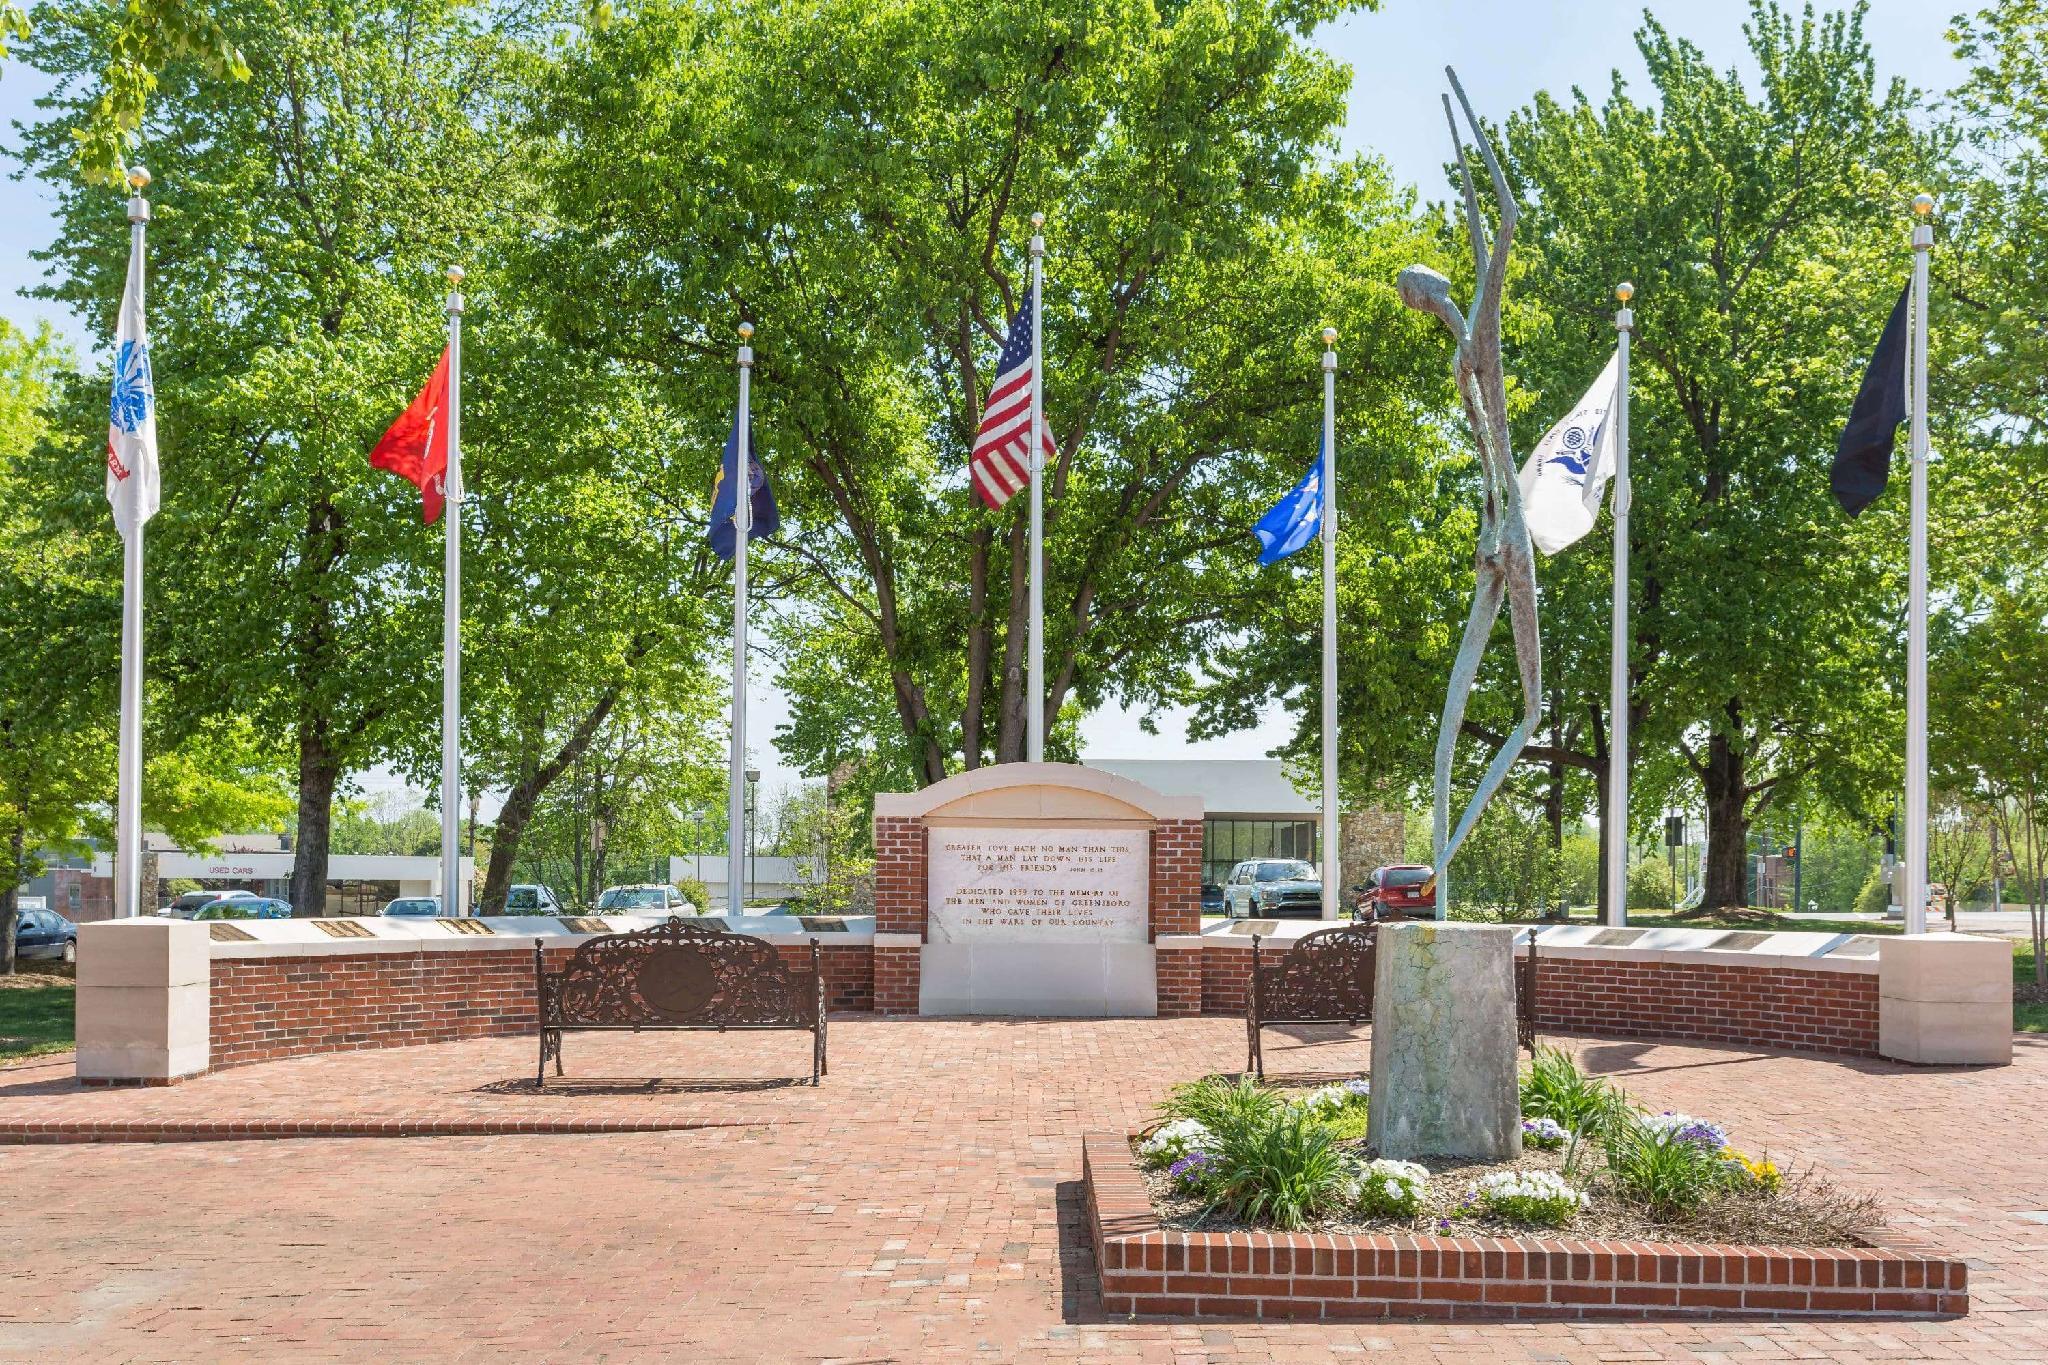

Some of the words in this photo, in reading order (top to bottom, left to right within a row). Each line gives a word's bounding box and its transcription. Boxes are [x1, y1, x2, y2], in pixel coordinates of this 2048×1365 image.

[232, 867, 254, 875] CARS
[945, 897, 962, 905] THE
[1071, 899, 1131, 907] GREENSBORO
[1007, 908, 1031, 916] GAVE
[1072, 919, 1115, 927] COUNTRY
